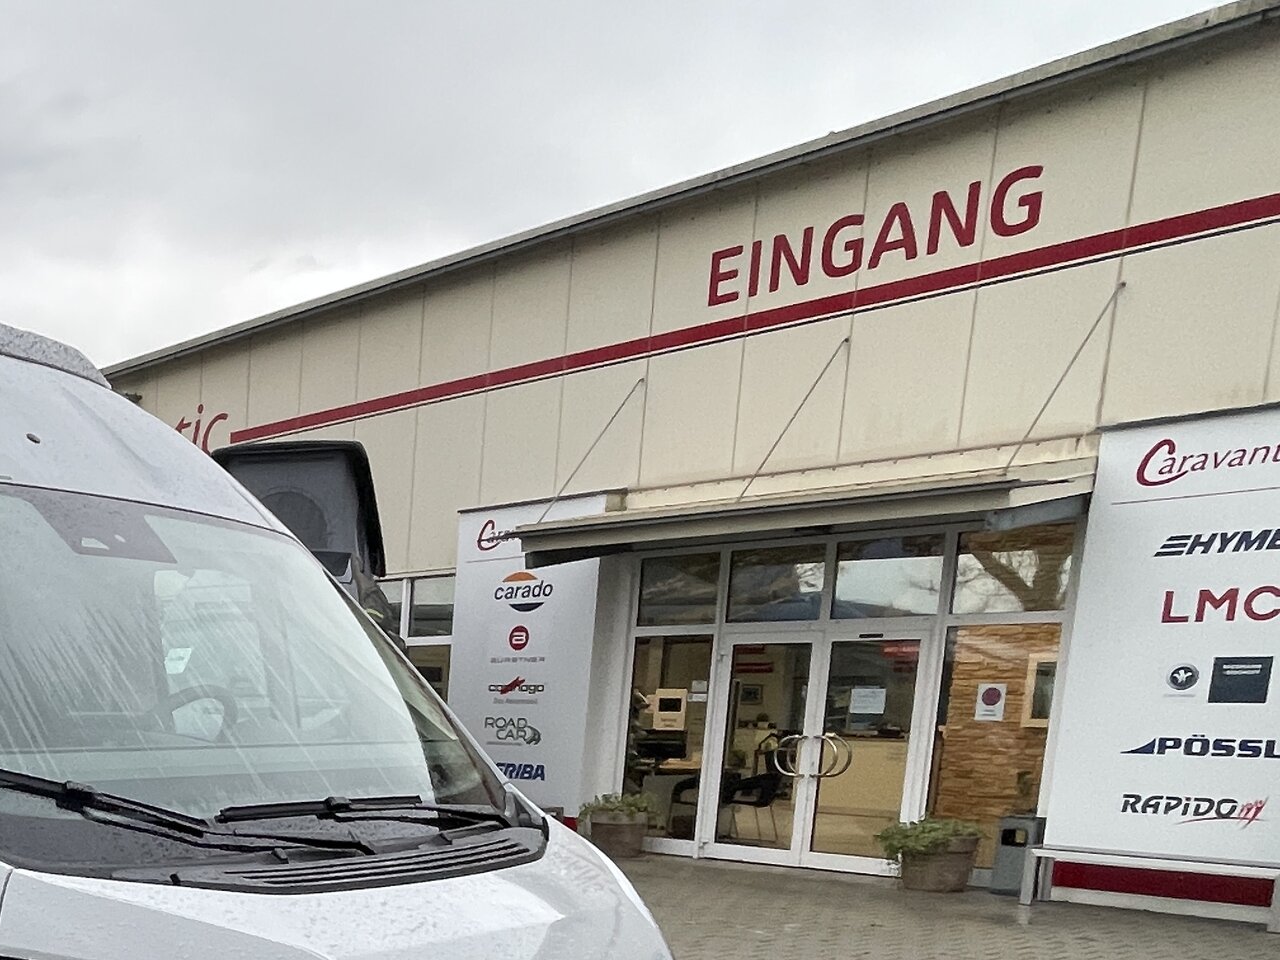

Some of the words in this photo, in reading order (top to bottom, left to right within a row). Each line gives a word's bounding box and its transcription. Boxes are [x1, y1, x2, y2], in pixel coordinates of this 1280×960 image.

[707, 165, 1044, 307] EINGANG
[494, 580, 554, 601] carado
[1161, 585, 1280, 624] LMC
[484, 716, 528, 729] ROAD
[496, 729, 527, 741] CAR
[1156, 733, 1280, 759] PÖSSL
